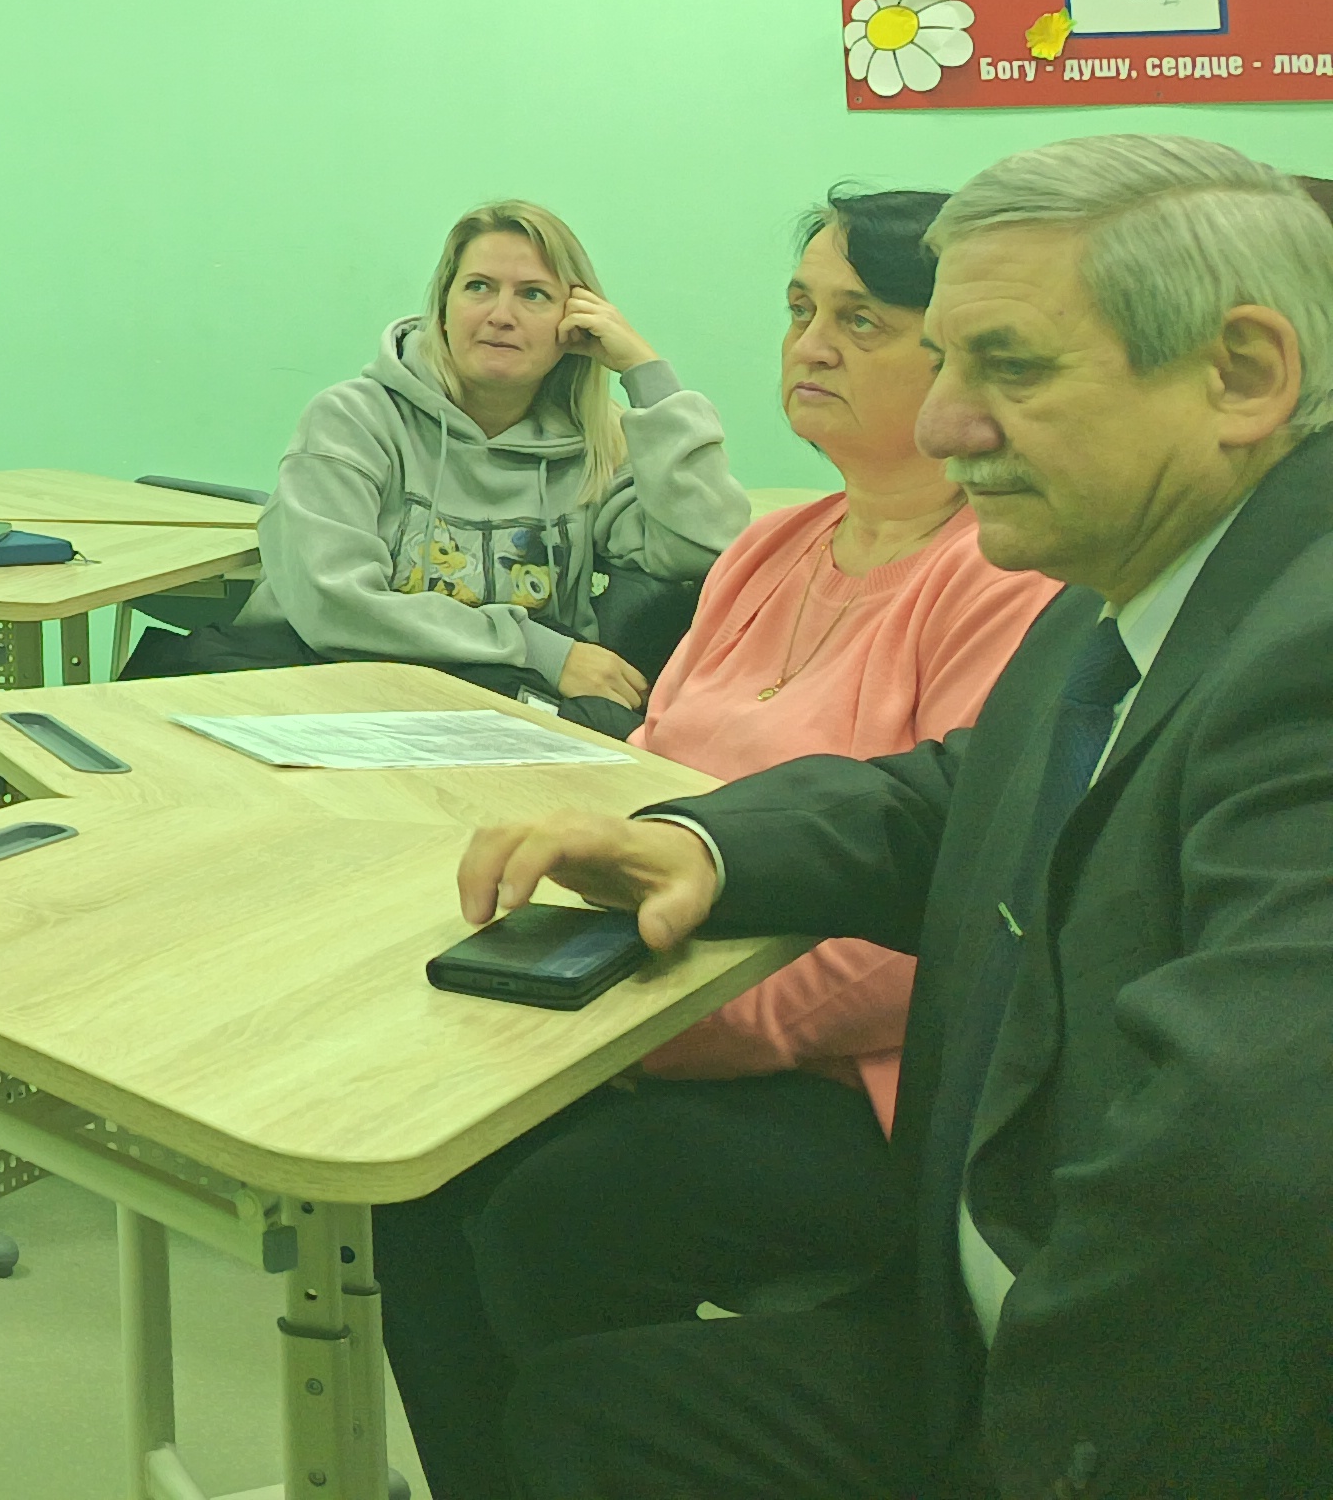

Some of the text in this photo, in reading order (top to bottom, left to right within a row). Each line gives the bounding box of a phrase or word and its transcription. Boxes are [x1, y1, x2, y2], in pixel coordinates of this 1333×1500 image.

[979, 57, 1037, 81] Богу
[1063, 58, 1138, 81] душу,
[1146, 54, 1243, 80] сердце
